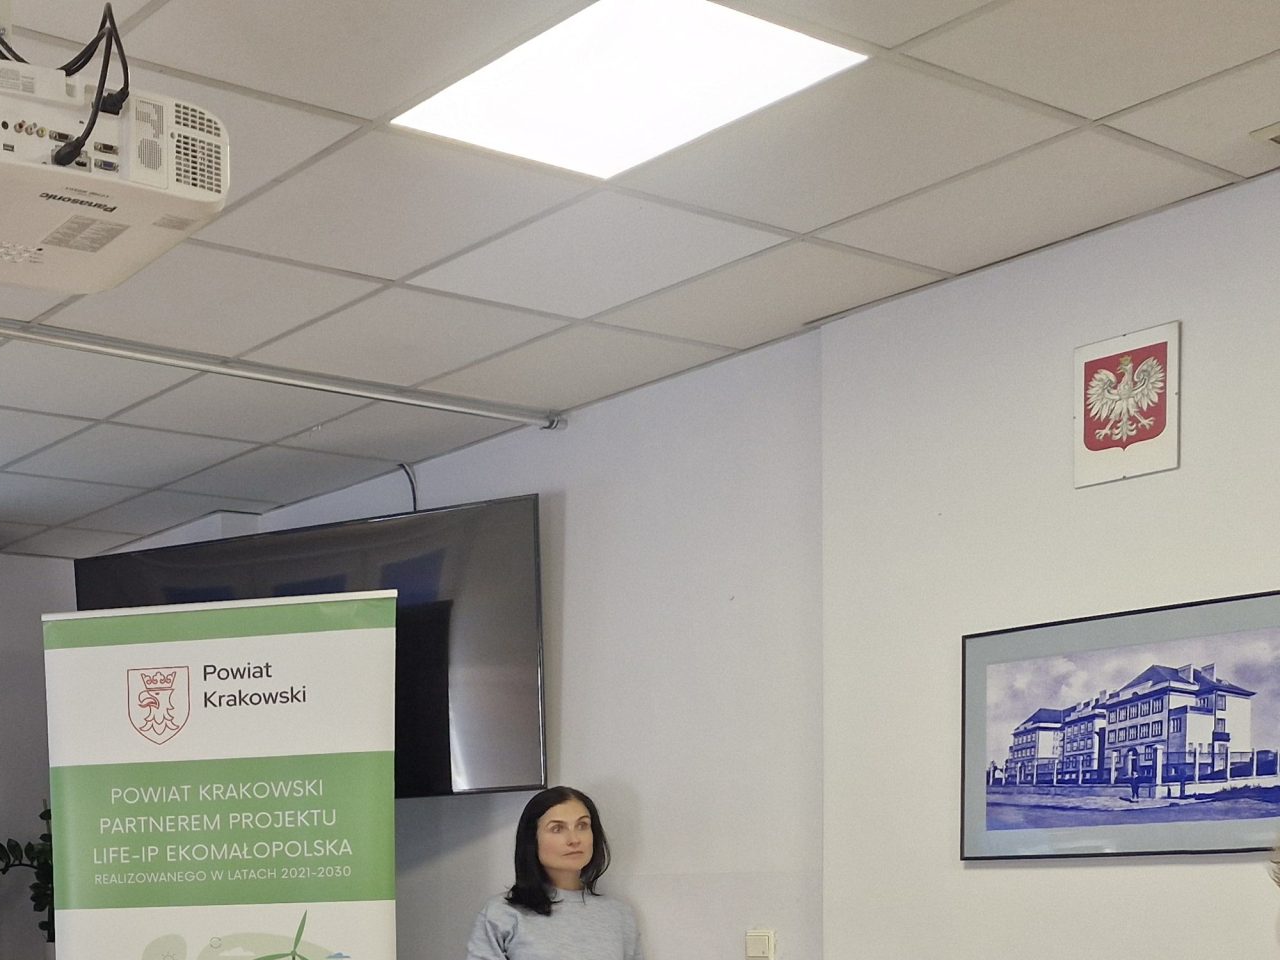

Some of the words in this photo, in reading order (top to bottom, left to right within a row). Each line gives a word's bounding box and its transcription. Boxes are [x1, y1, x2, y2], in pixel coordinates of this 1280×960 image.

[39, 192, 118, 213] Panasonic
[203, 662, 272, 681] Powiat
[203, 685, 306, 708] Krakowski
[111, 784, 192, 805] POWIAT
[199, 779, 323, 801] KRAKOWSKI
[99, 813, 220, 834] PARTNEREM
[229, 808, 336, 830] PROJEKTU
[93, 845, 158, 864] LIFE-IP
[166, 838, 353, 862] EKOMAŁOPOLSKA
[94, 870, 207, 885] REALIZOWANEGO
[210, 869, 224, 881] W
[228, 867, 277, 881] LATACH
[281, 865, 352, 879] 2021-2030
